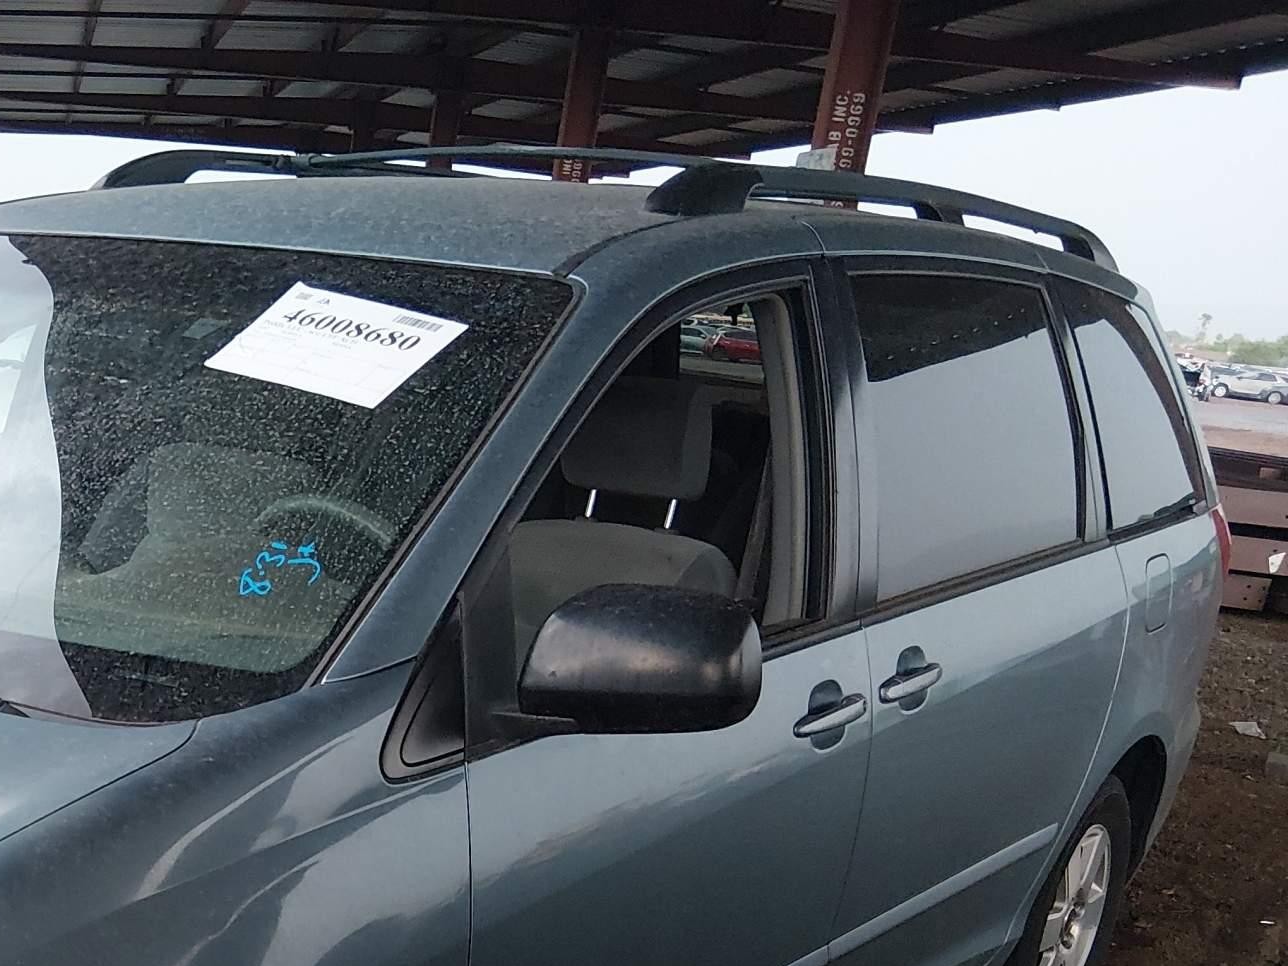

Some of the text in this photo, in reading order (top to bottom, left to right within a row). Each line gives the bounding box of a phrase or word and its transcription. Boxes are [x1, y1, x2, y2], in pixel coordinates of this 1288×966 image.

[832, 90, 851, 122] INC.
[839, 92, 866, 168] 99-0969
[281, 309, 421, 351] 46008680
